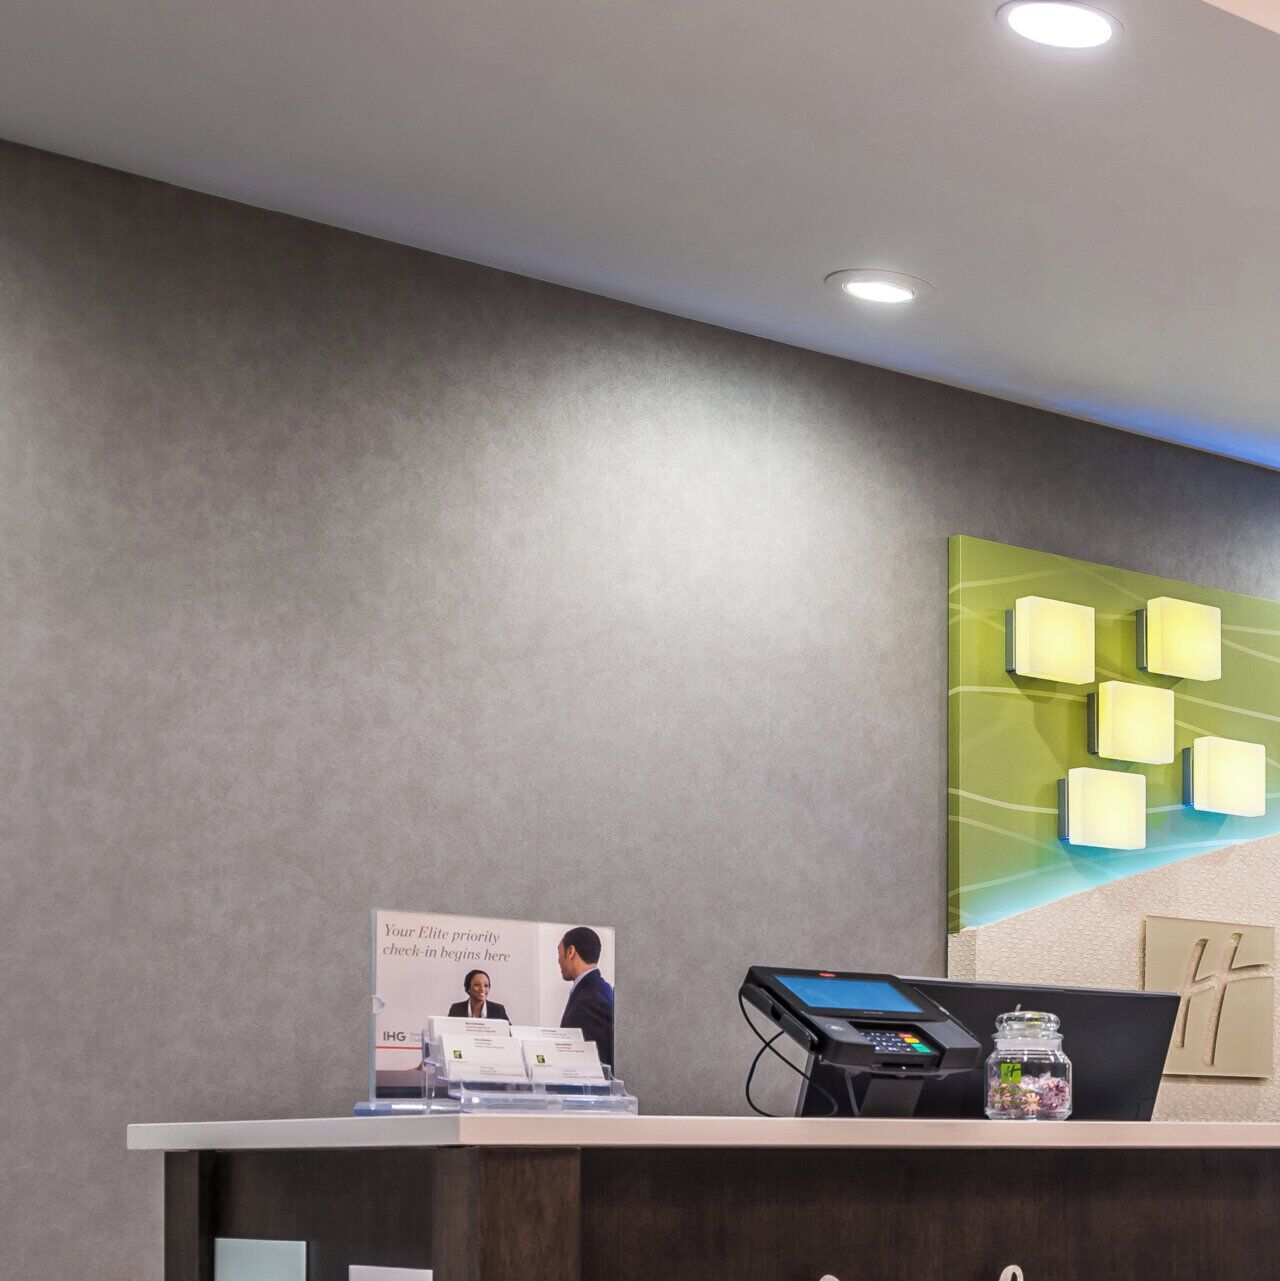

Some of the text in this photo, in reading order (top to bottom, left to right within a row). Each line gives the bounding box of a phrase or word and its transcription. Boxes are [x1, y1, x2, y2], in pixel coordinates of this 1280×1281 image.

[385, 924, 500, 945] Your Elite priority
[382, 943, 511, 962] check-in begins here
[383, 1031, 406, 1041] IHG
